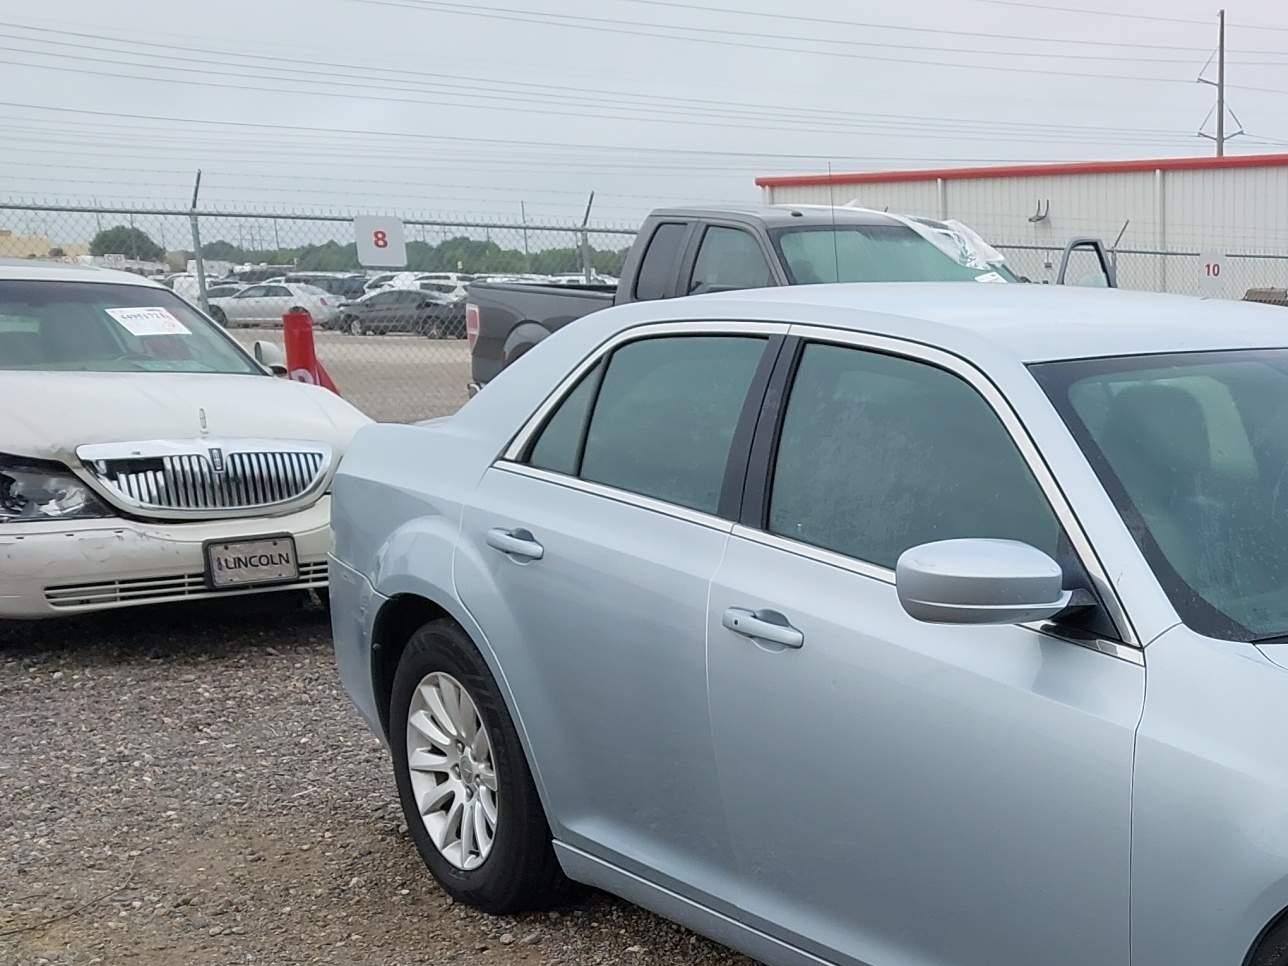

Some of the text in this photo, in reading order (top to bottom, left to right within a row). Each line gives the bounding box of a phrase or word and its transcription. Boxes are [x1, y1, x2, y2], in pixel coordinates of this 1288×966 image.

[373, 230, 388, 248] 8
[1205, 263, 1220, 277] 10
[225, 552, 290, 570] LINCOLN
